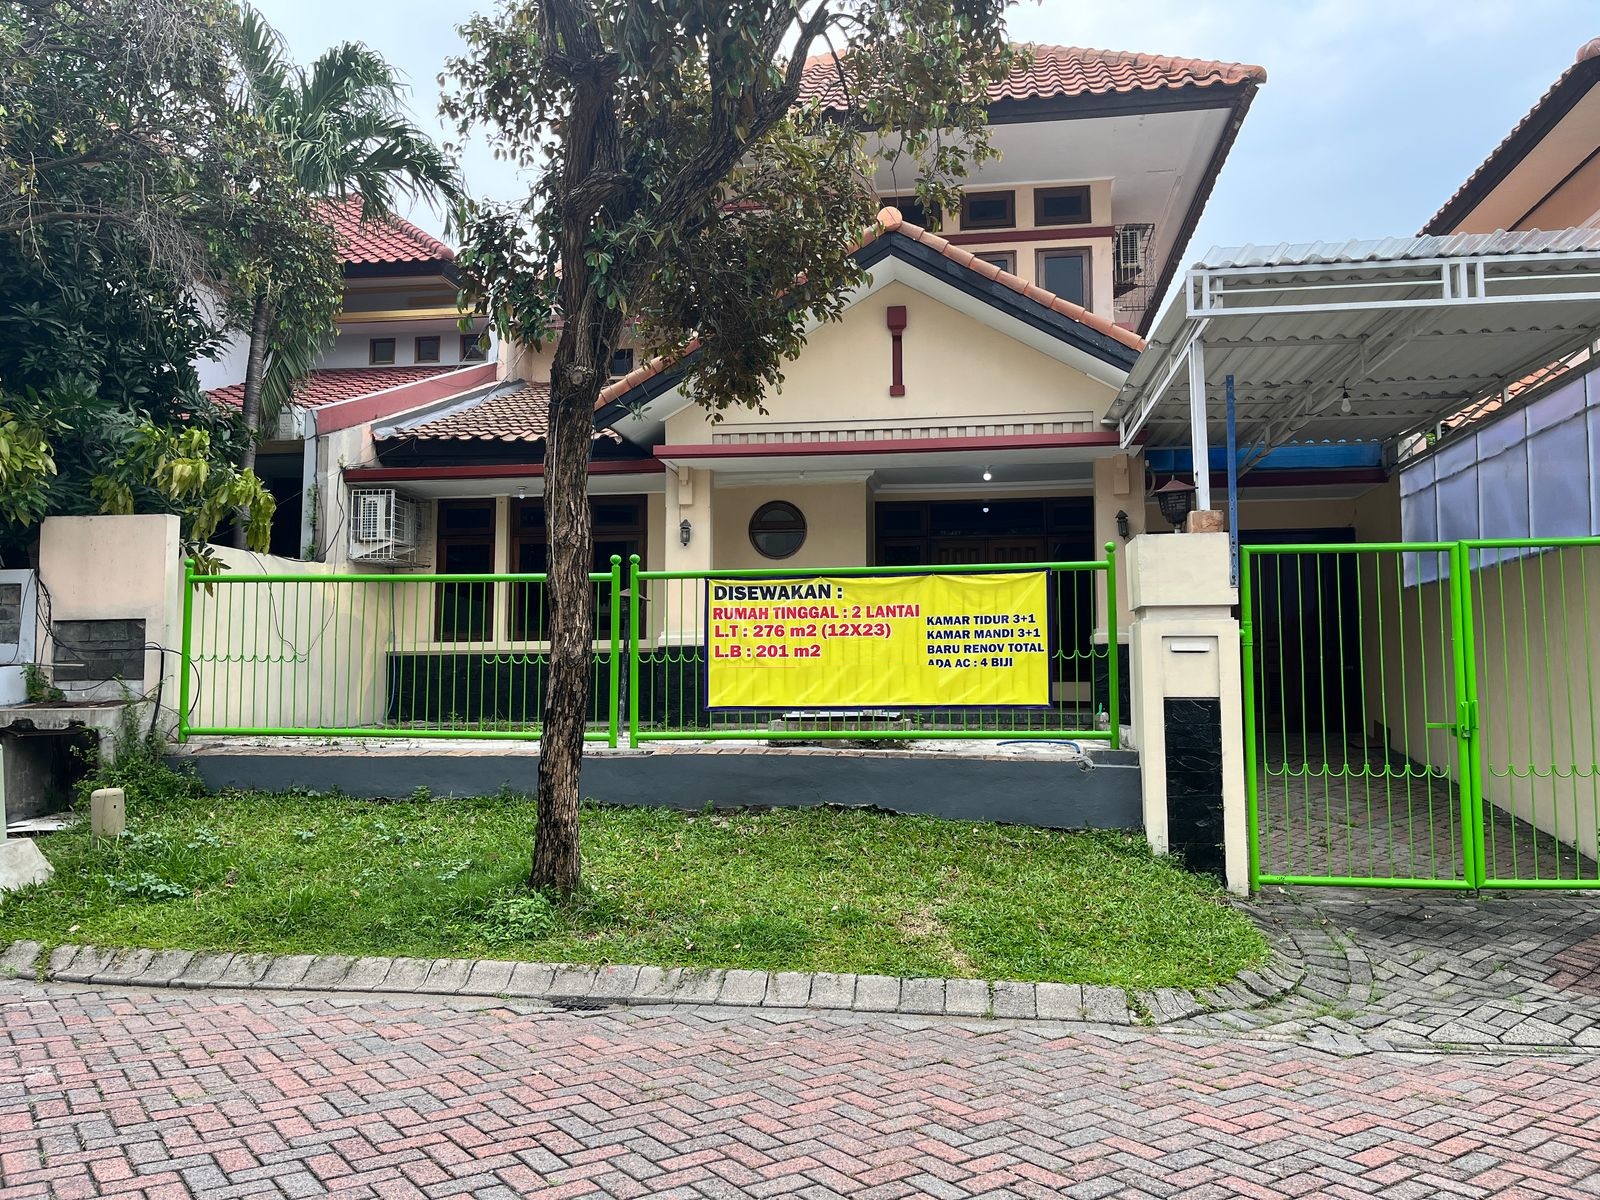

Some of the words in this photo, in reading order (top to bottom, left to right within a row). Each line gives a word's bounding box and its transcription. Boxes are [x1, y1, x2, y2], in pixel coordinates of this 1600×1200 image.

[714, 584, 831, 600] DISEWAKAN
[713, 607, 769, 619] RUMAH
[773, 607, 839, 619] TINGGAL
[852, 606, 861, 618] 2
[866, 605, 919, 618] LANTAI
[927, 616, 970, 625] KAMAR
[973, 615, 1009, 624] TIDUR
[1013, 614, 1035, 623] 3+1
[753, 625, 784, 637] 276
[790, 624, 817, 636] m2
[821, 624, 891, 639] (12X23)
[927, 630, 970, 639] KAMAR
[974, 629, 1014, 638] MANDI
[1018, 629, 1040, 637] 3+1
[756, 645, 788, 657] 201
[794, 645, 820, 657] m2
[928, 645, 959, 654] BARU
[964, 644, 1004, 653] RENOV
[1008, 643, 1044, 652] TOTAL
[928, 659, 951, 668] ADA
[955, 659, 970, 667] AC
[981, 658, 988, 667] 4
[992, 658, 1012, 667] BIJI
